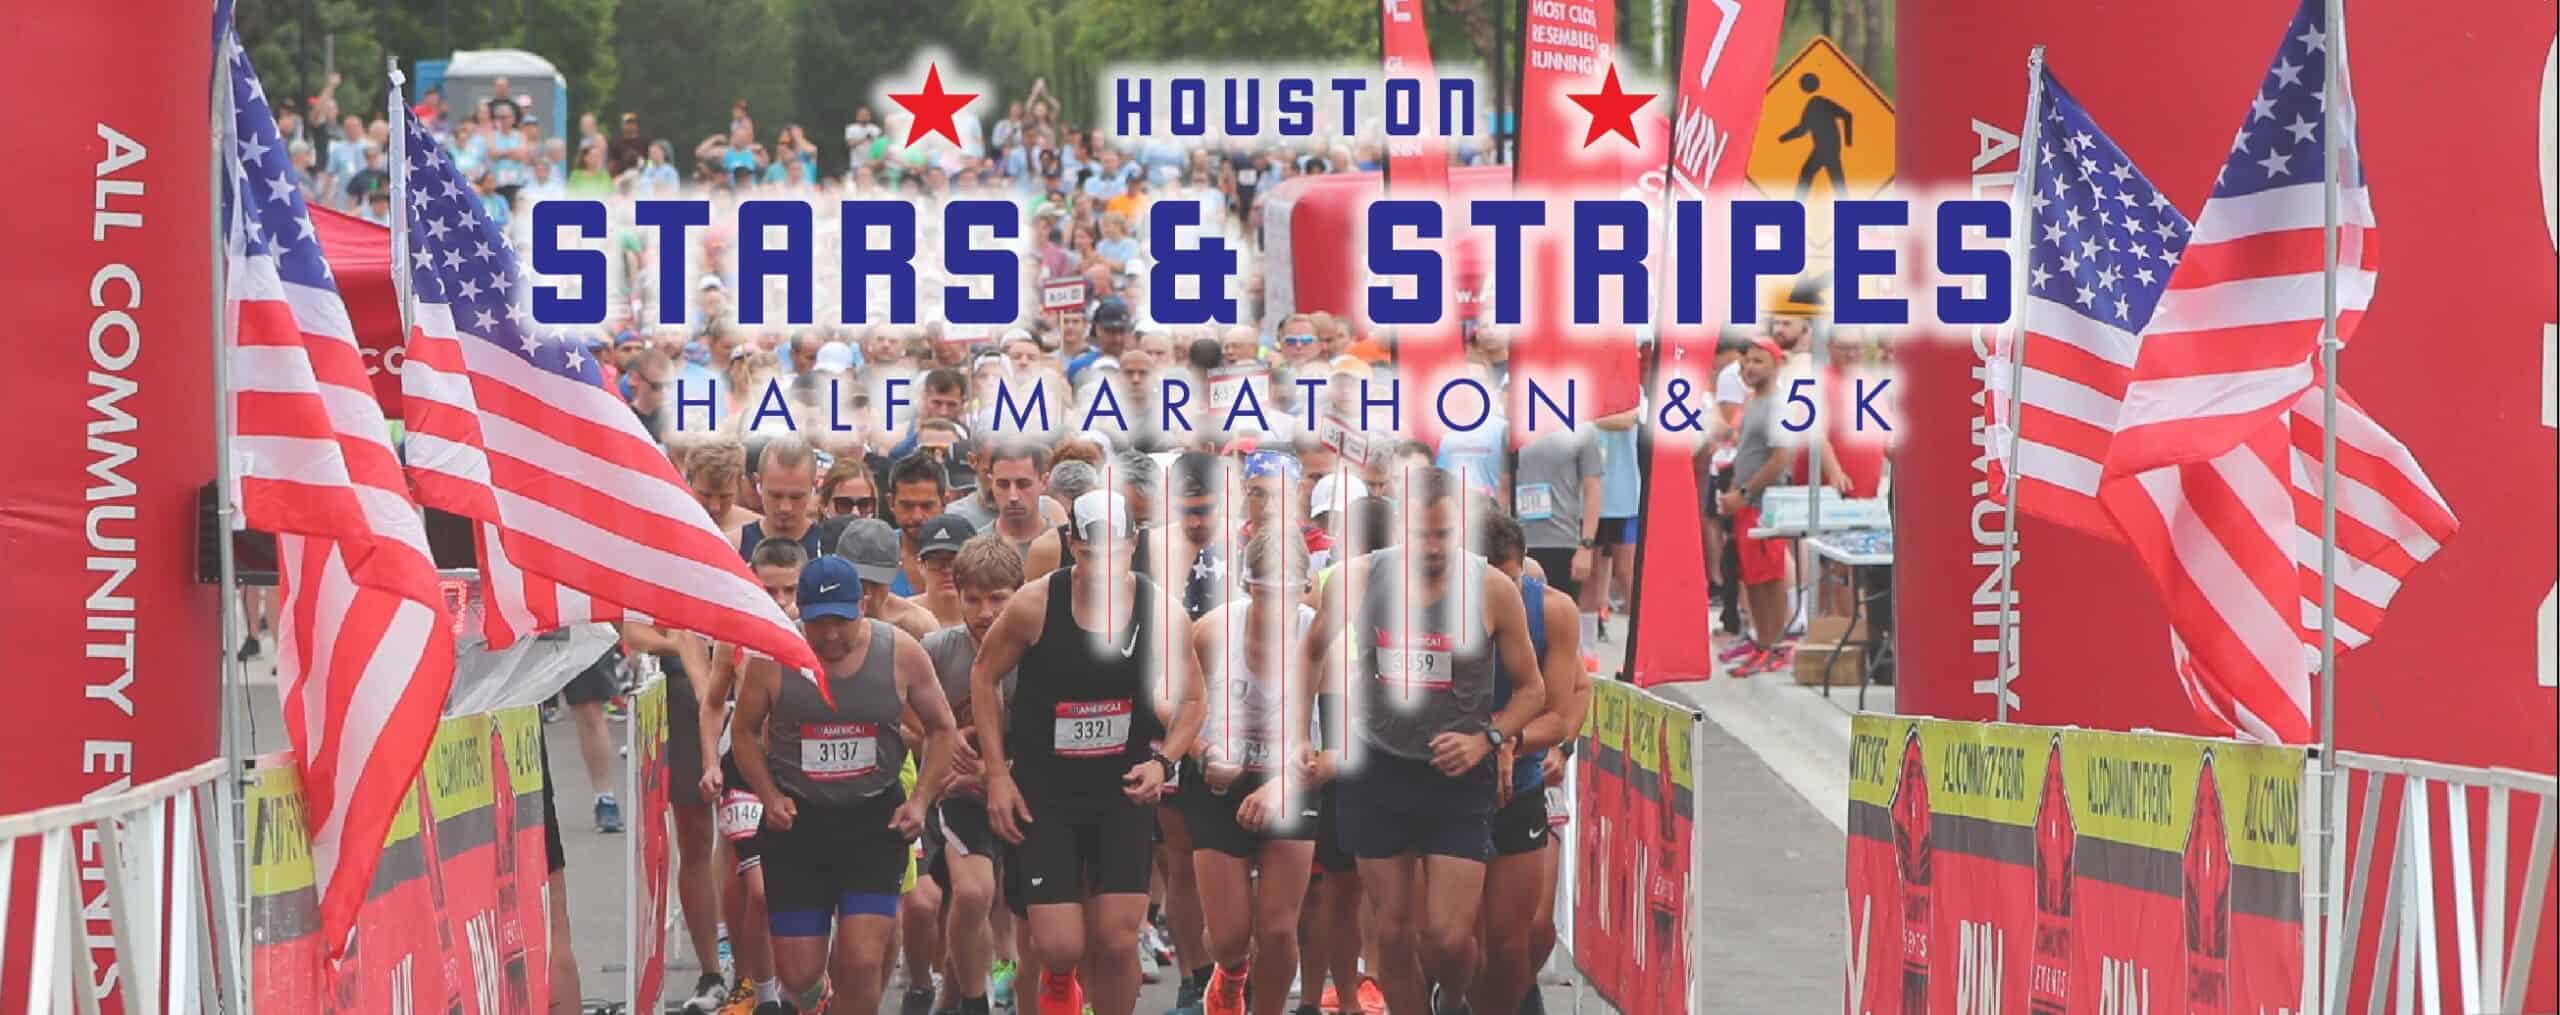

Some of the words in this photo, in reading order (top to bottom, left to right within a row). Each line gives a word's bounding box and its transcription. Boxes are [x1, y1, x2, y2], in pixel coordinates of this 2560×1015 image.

[1531, 49, 1593, 75] RUNNING
[1674, 93, 1729, 190] MIN
[92, 122, 147, 242] ALL
[83, 264, 143, 717] COMMUNITY
[1073, 719, 1112, 740] 3321
[818, 741, 859, 761] 3137
[725, 804, 758, 825] 3146
